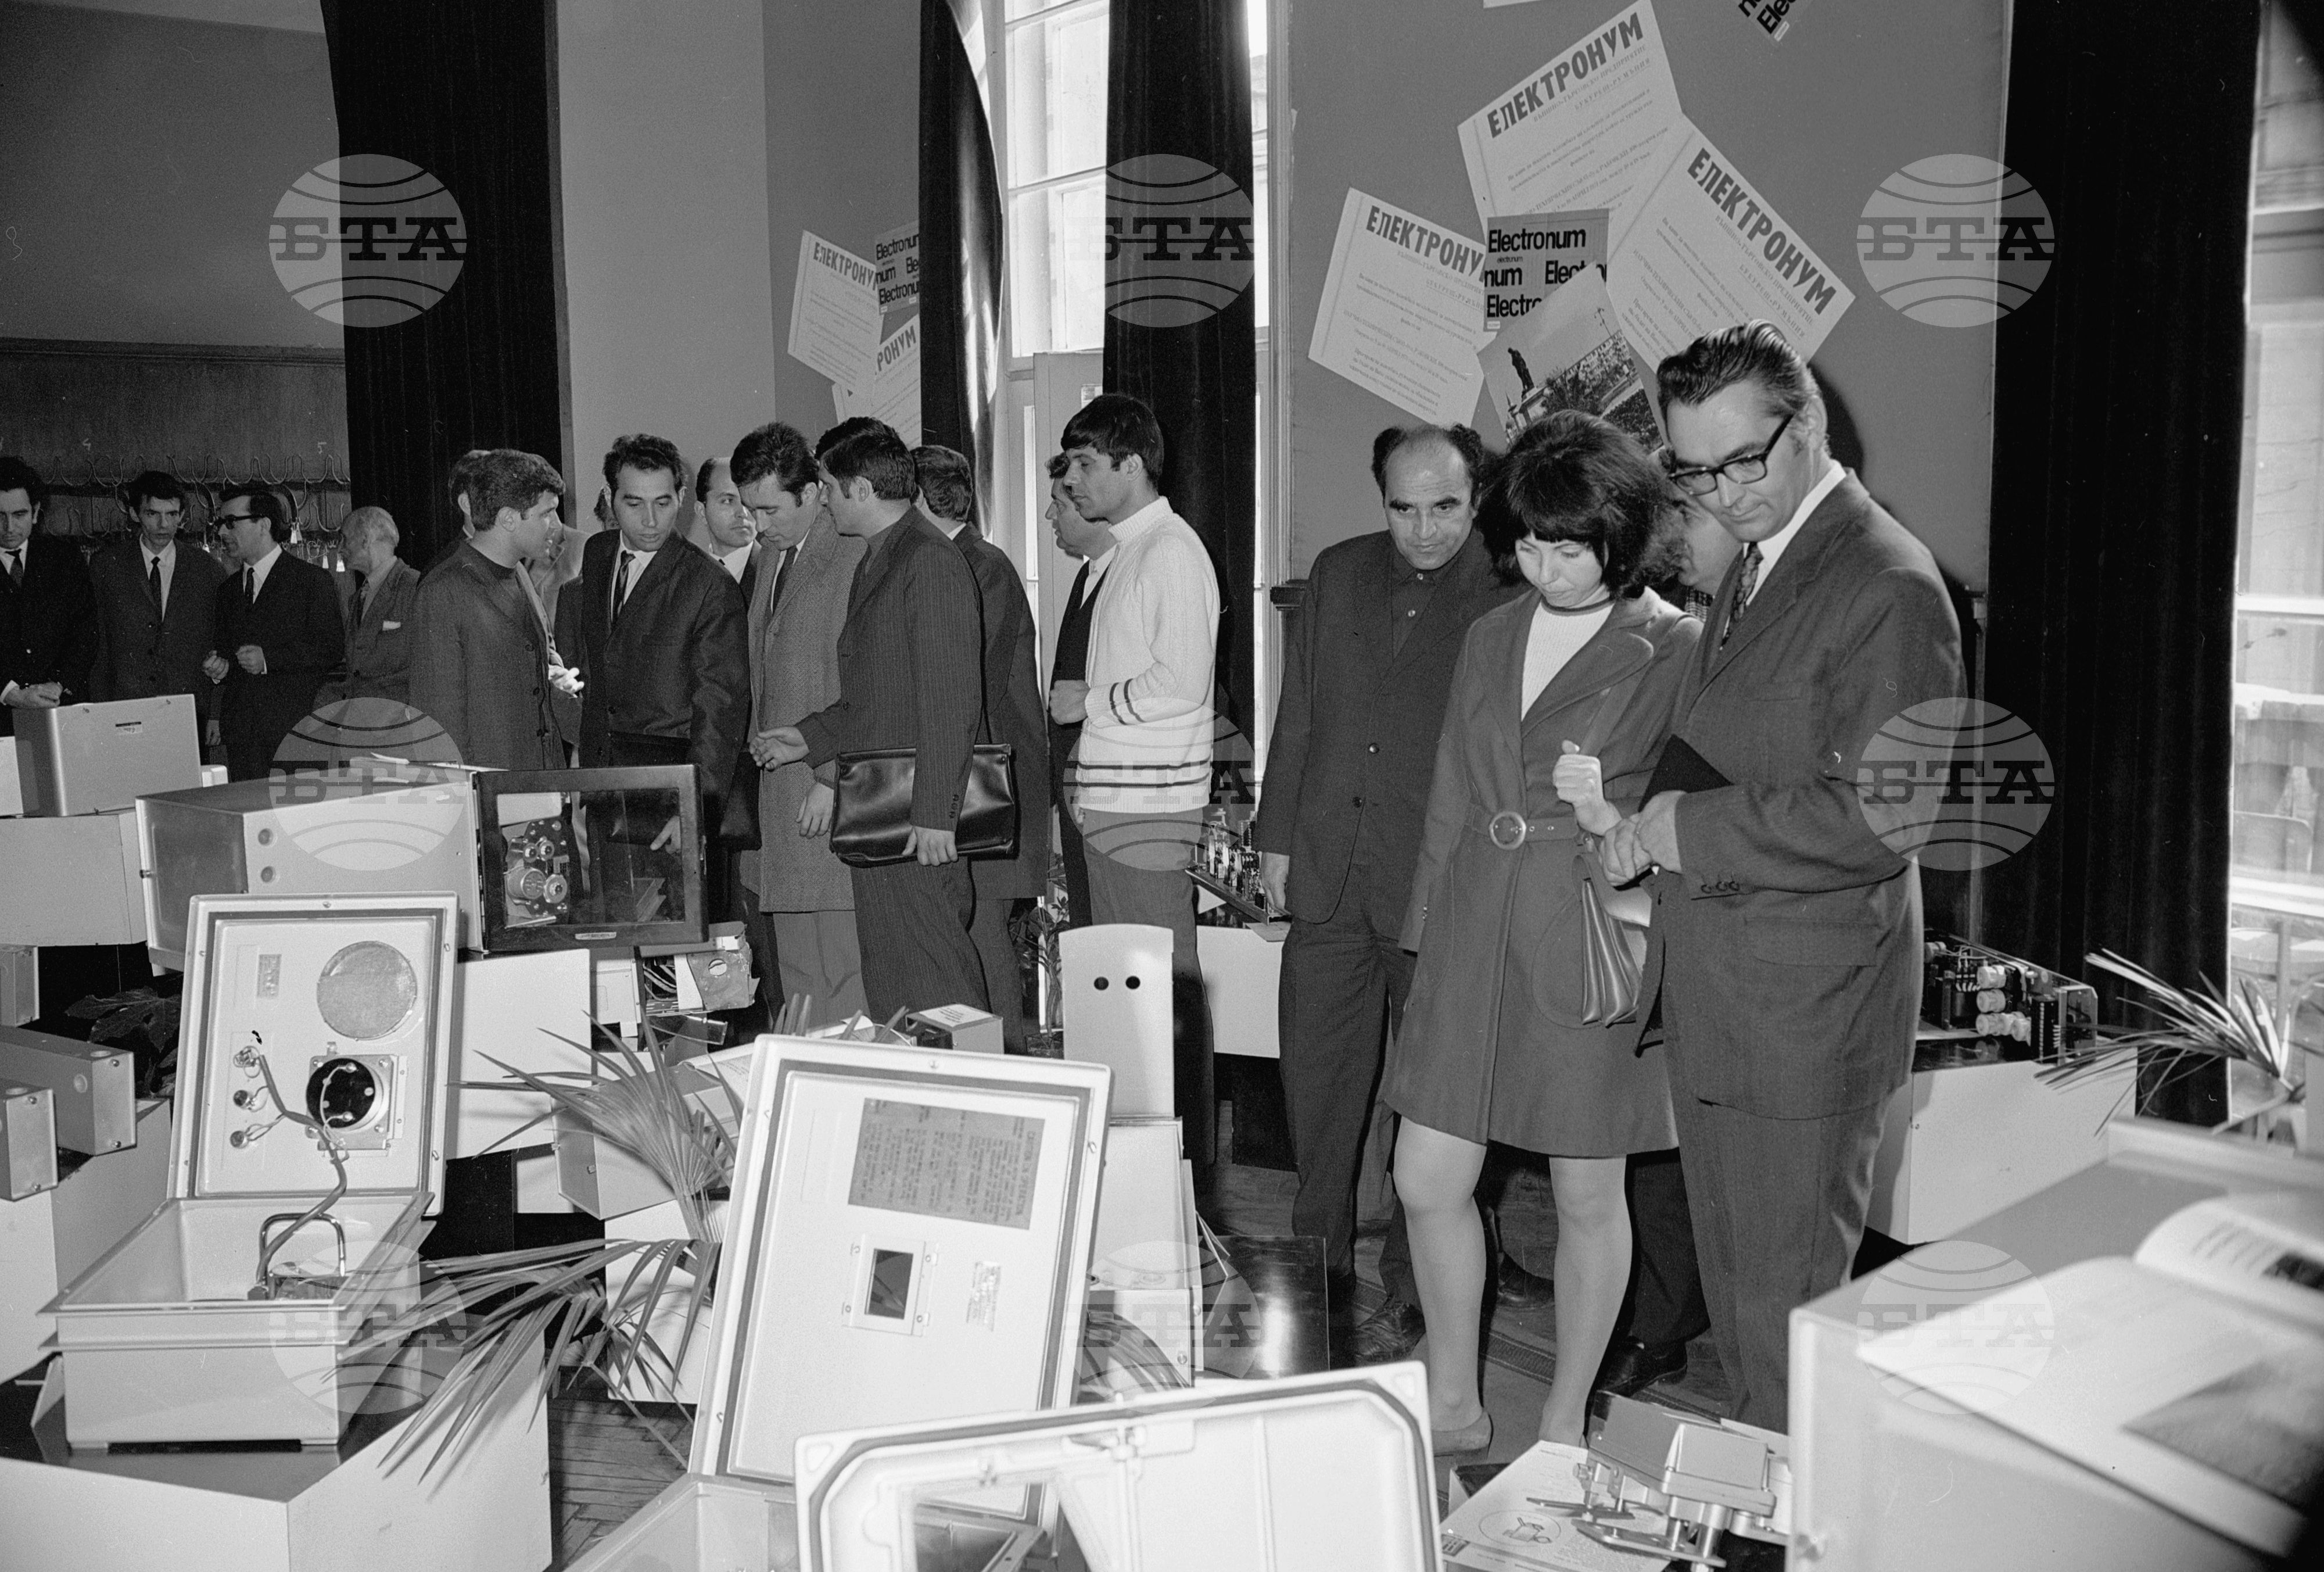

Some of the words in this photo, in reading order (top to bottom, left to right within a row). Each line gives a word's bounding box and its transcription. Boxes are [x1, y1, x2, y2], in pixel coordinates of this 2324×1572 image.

[1757, 0, 1796, 34] Ele
[1485, 10, 1644, 139] ЕЛЕКТРОНУМ
[1488, 228, 1586, 253] Electronum
[1685, 146, 1838, 316] ЕЛЕКТРОНУМ
[813, 242, 877, 291] ЕЛЕКТРОНУ
[1484, 267, 1523, 287] num
[875, 325, 917, 375] РОНУМ
